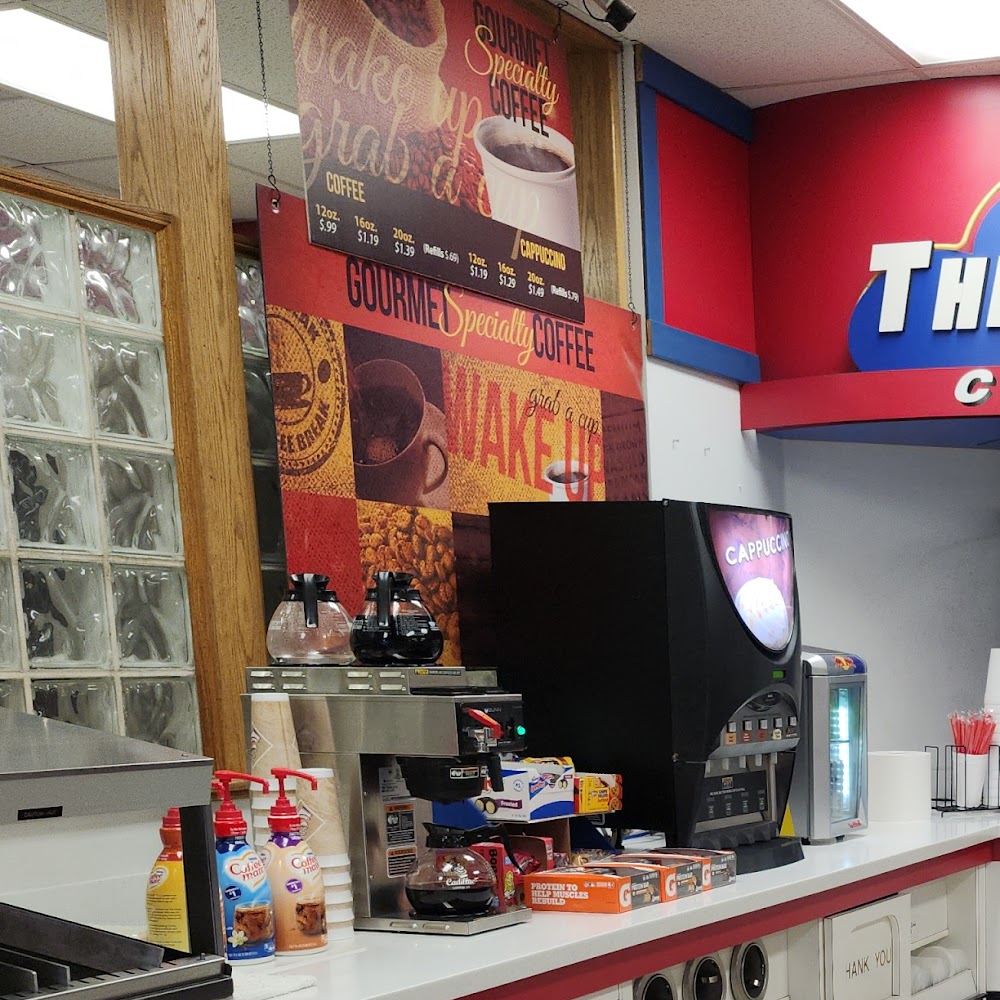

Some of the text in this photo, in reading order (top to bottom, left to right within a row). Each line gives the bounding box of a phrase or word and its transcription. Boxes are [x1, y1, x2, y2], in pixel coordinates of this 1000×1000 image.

[472, 1, 551, 71] GOURMET
[465, 25, 560, 116] Specialty
[489, 71, 550, 138] COFFEE
[326, 171, 366, 203] COFFEE
[315, 203, 416, 244] 12oz. 16oz. 20oz.
[319, 219, 337, 234] $.99
[357, 231, 379, 247] $1.19
[394, 241, 415, 258] $1.39
[468, 252, 546, 286] 12oz. 16oz. 20oz.
[520, 238, 566, 271] CAPPUCCINO
[470, 265, 489, 280] $1.19
[499, 274, 516, 288] $1.29
[528, 284, 545, 298] $1.49
[346, 257, 449, 332] GOURMET
[439, 283, 536, 366] Specialty
[532, 314, 595, 372] COFFEE
[296, 402, 330, 452] BREAK
[526, 385, 600, 443] grab a cup
[452, 365, 554, 492] WAKE
[564, 424, 606, 502] UP
[500, 800, 519, 808] Frosted
[446, 877, 480, 887] Cadillac
[531, 883, 566, 891] PROTEIN
[665, 873, 677, 897] G
[702, 863, 711, 887] G
[531, 891, 589, 900] HELP MUSCLES
[531, 898, 566, 906] REBUILD
[620, 883, 632, 908] G
